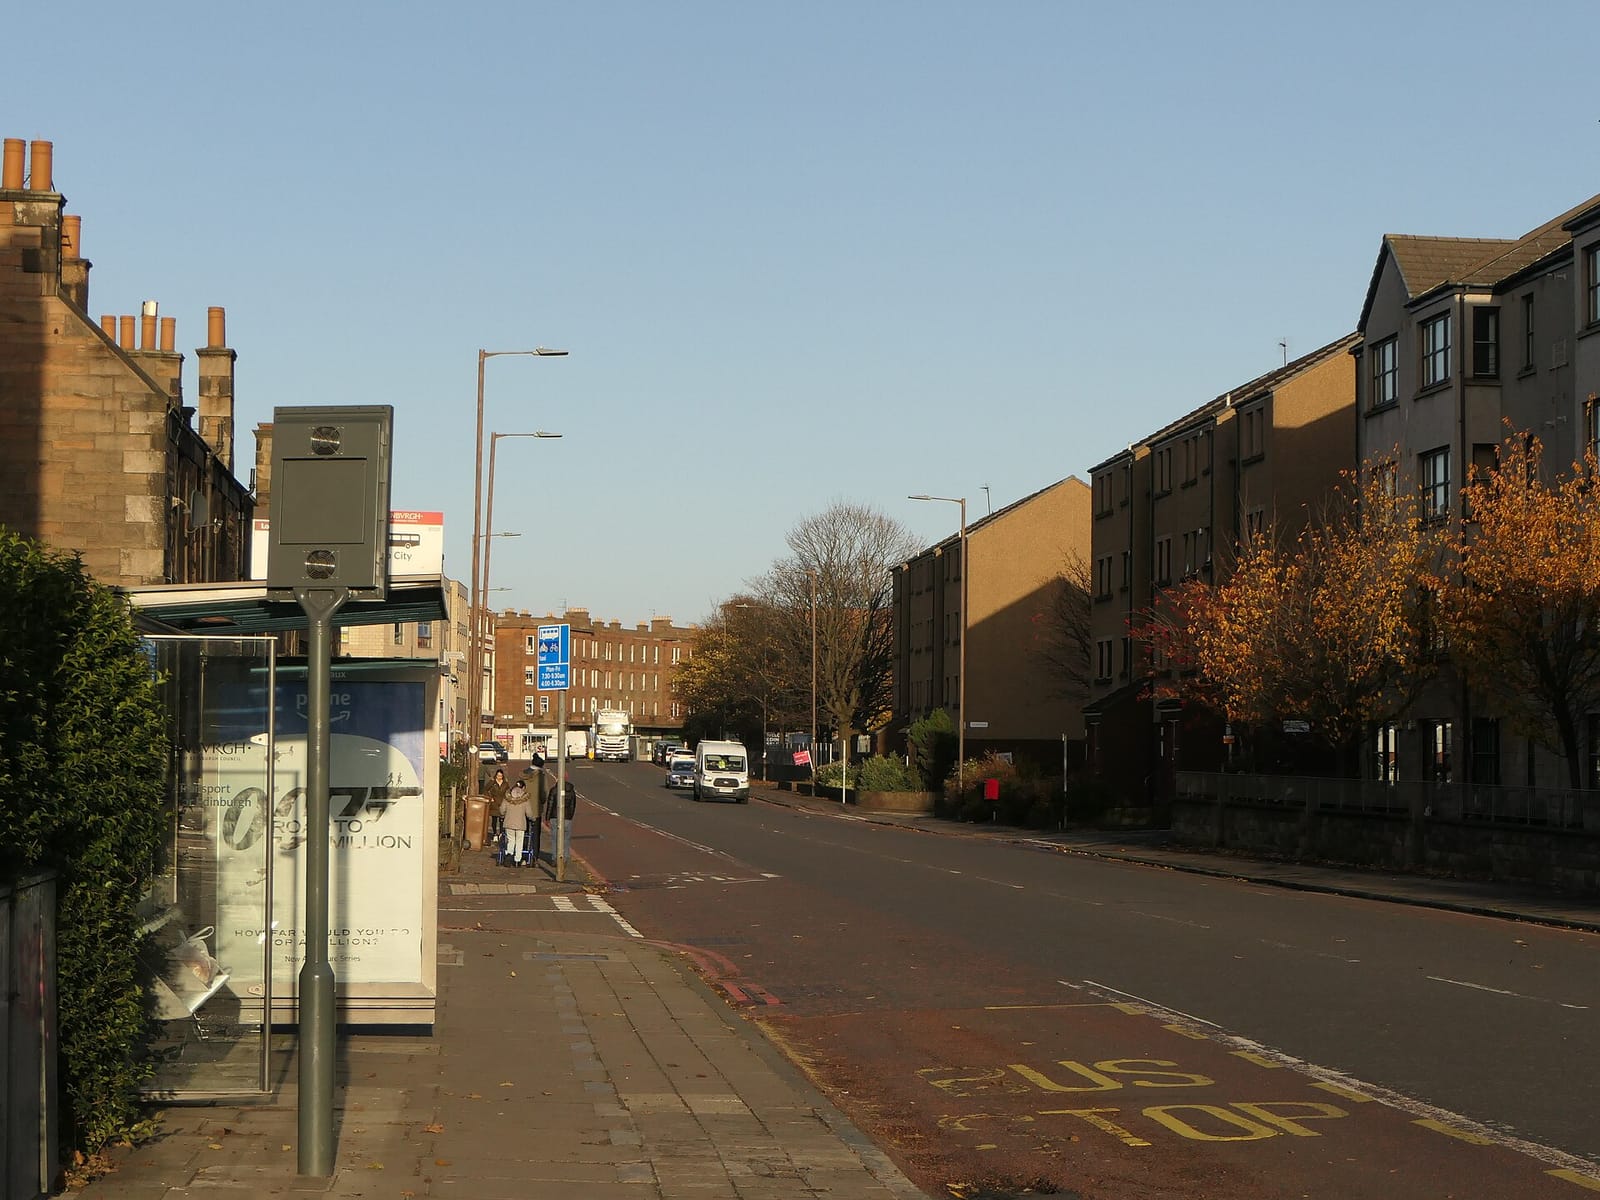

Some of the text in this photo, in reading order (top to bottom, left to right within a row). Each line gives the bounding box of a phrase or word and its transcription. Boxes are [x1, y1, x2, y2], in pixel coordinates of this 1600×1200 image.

[393, 551, 412, 561] City
[334, 820, 363, 833] TO
[331, 835, 411, 849] MILLION
